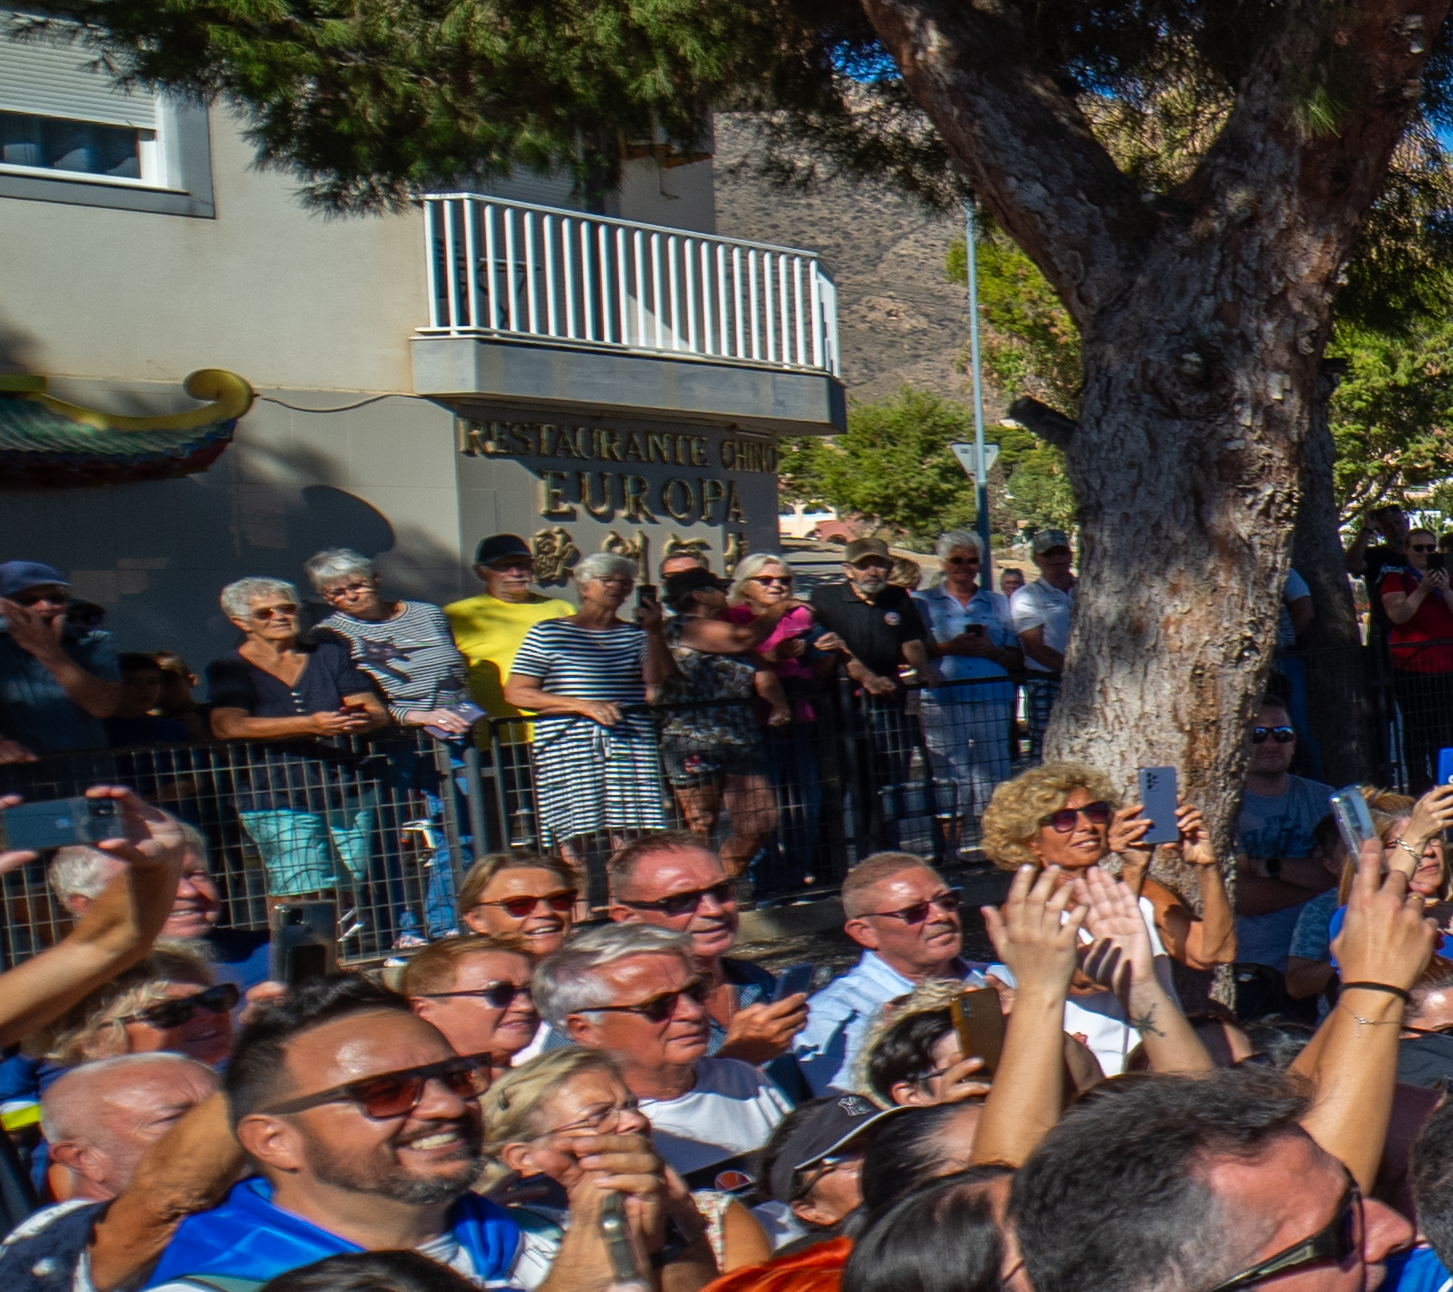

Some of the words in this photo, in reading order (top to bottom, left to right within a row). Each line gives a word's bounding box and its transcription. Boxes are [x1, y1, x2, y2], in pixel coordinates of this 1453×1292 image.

[459, 417, 709, 467] RESTAURANTE
[720, 438, 778, 474] CHINO
[540, 469, 747, 525] EUROPA
